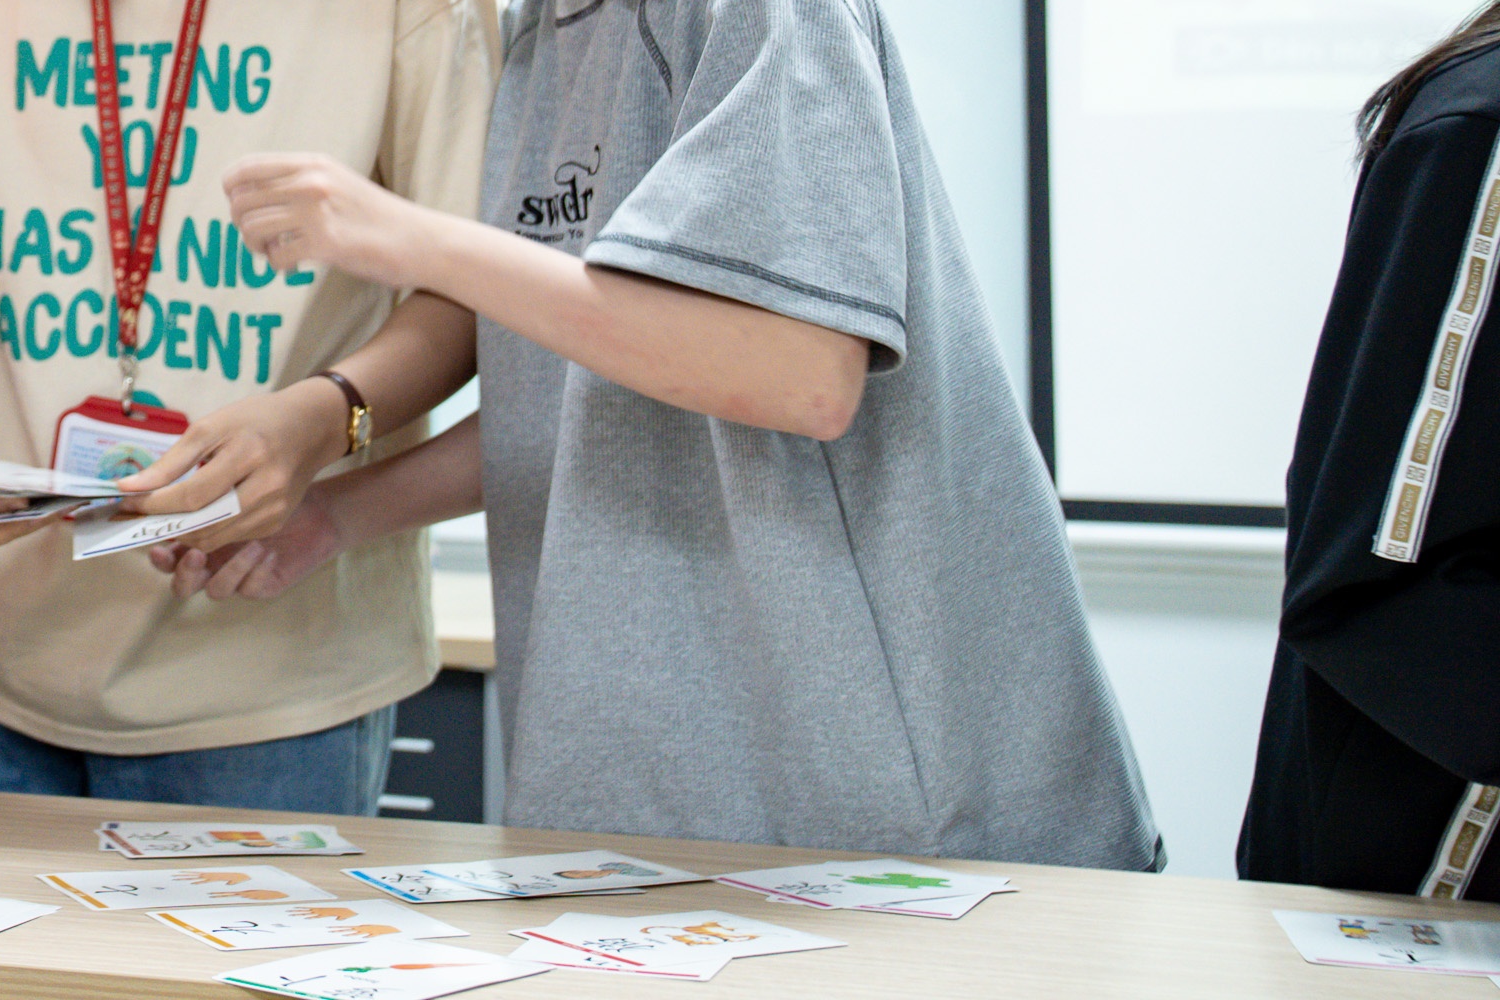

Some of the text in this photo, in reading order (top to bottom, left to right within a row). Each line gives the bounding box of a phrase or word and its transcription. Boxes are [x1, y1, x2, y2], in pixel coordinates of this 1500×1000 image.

[14, 37, 271, 114] MEETNG
[1463, 259, 1483, 311] GIVENCHY
[1437, 335, 1459, 388] GIVENCHY
[1414, 411, 1439, 463] GIVENCHY
[1396, 487, 1417, 540] GIVENCHY
[94, 884, 139, 896] 七
[210, 919, 276, 936] 九
